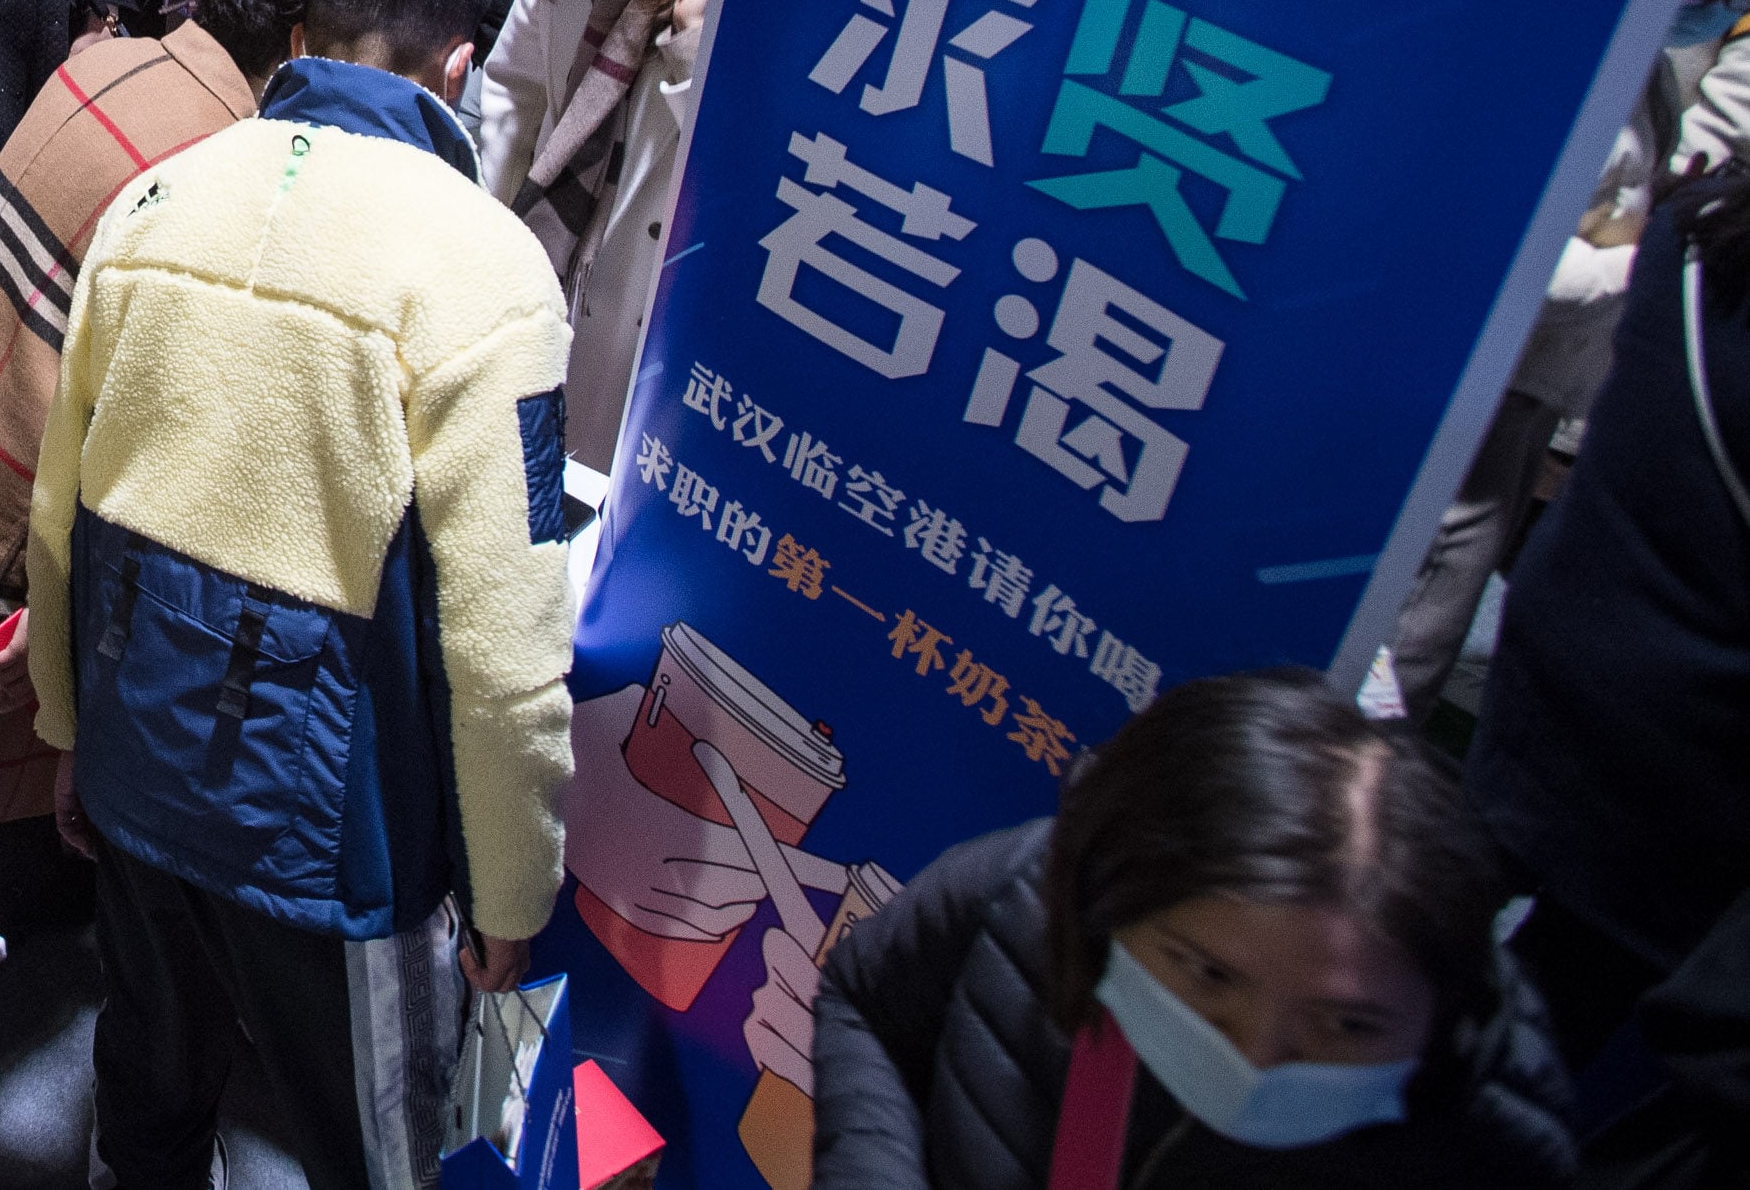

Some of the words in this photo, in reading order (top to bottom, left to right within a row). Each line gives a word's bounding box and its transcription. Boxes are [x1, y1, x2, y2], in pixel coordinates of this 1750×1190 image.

[756, 131, 1227, 523] 若渴
[636, 430, 1099, 786] 求职的第一杯奶茶
[681, 360, 1163, 714] 武汉临空港请你喝
